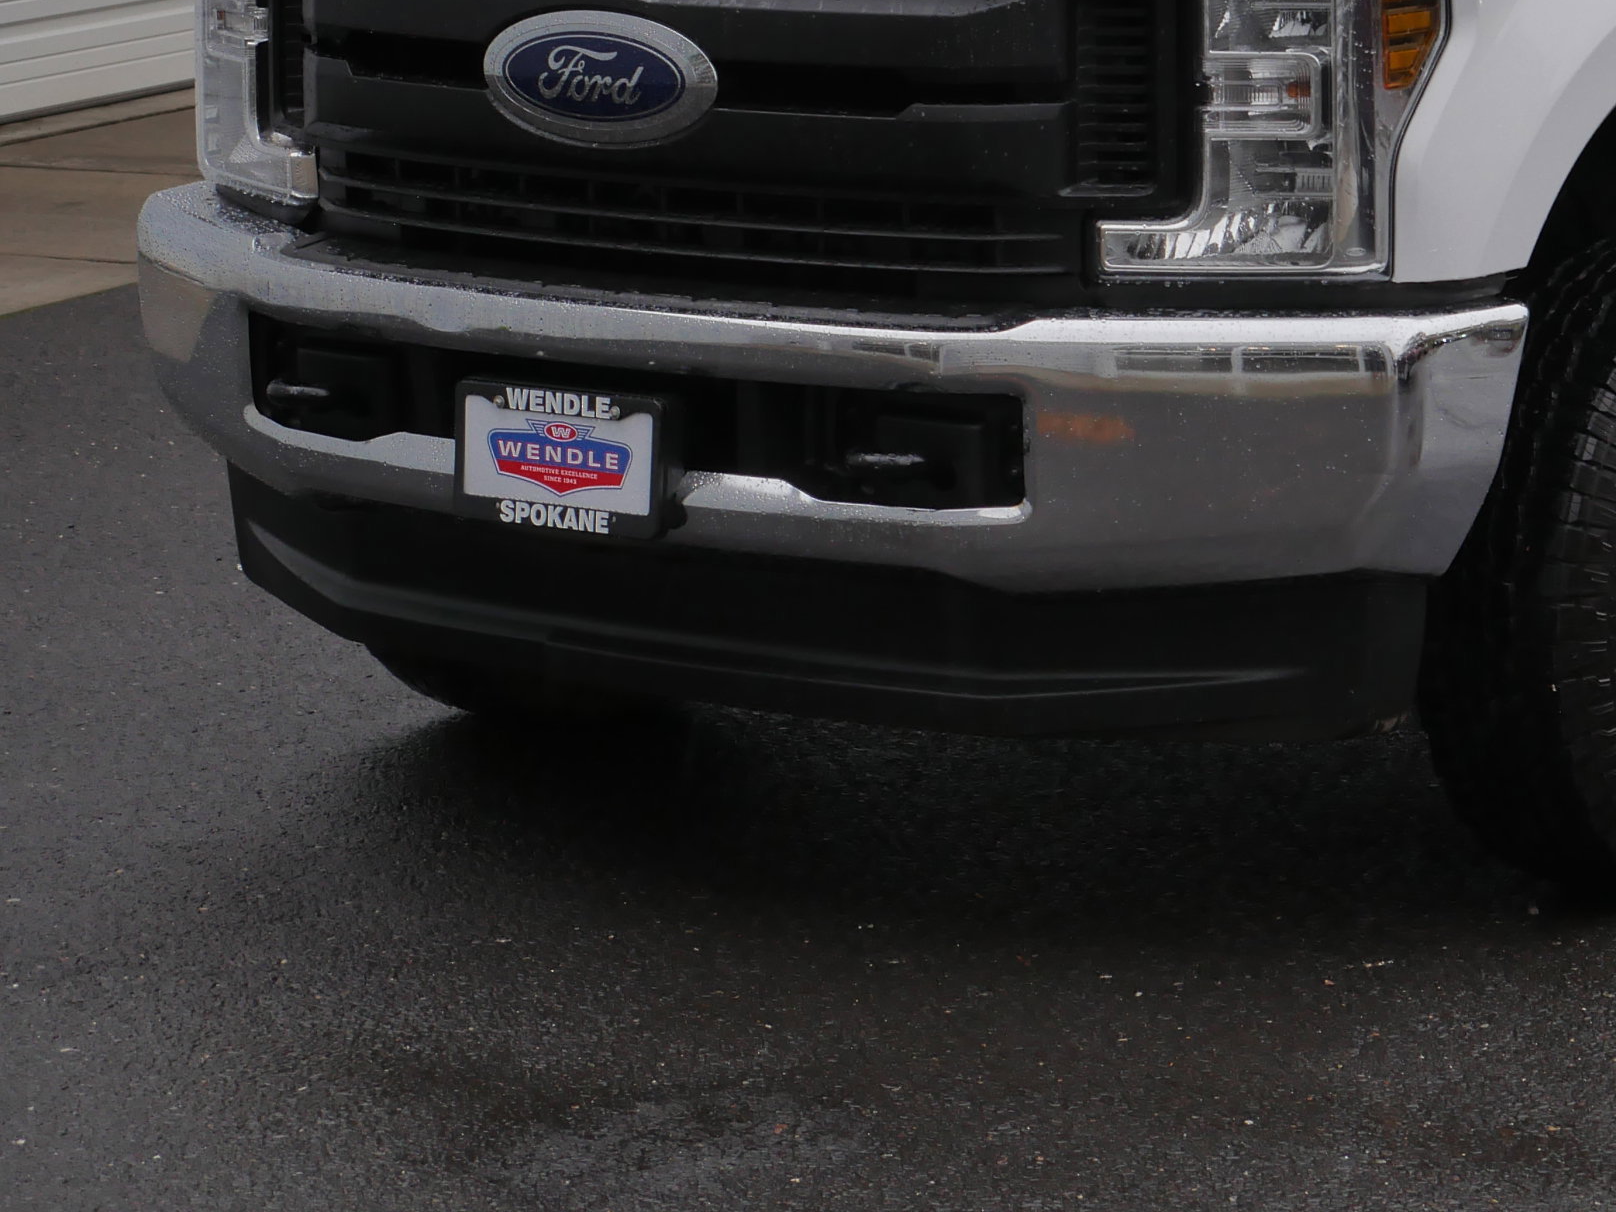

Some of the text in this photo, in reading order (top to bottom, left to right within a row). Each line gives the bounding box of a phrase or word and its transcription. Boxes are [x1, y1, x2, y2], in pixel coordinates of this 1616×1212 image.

[537, 44, 645, 106] Ford
[506, 387, 611, 419] WENDLE
[499, 440, 619, 469] WENDLE
[521, 465, 598, 479] AUTOMOTIVE EXCELLENCE
[543, 474, 577, 485] SINCE 1943
[500, 500, 609, 534] SPOKANE
